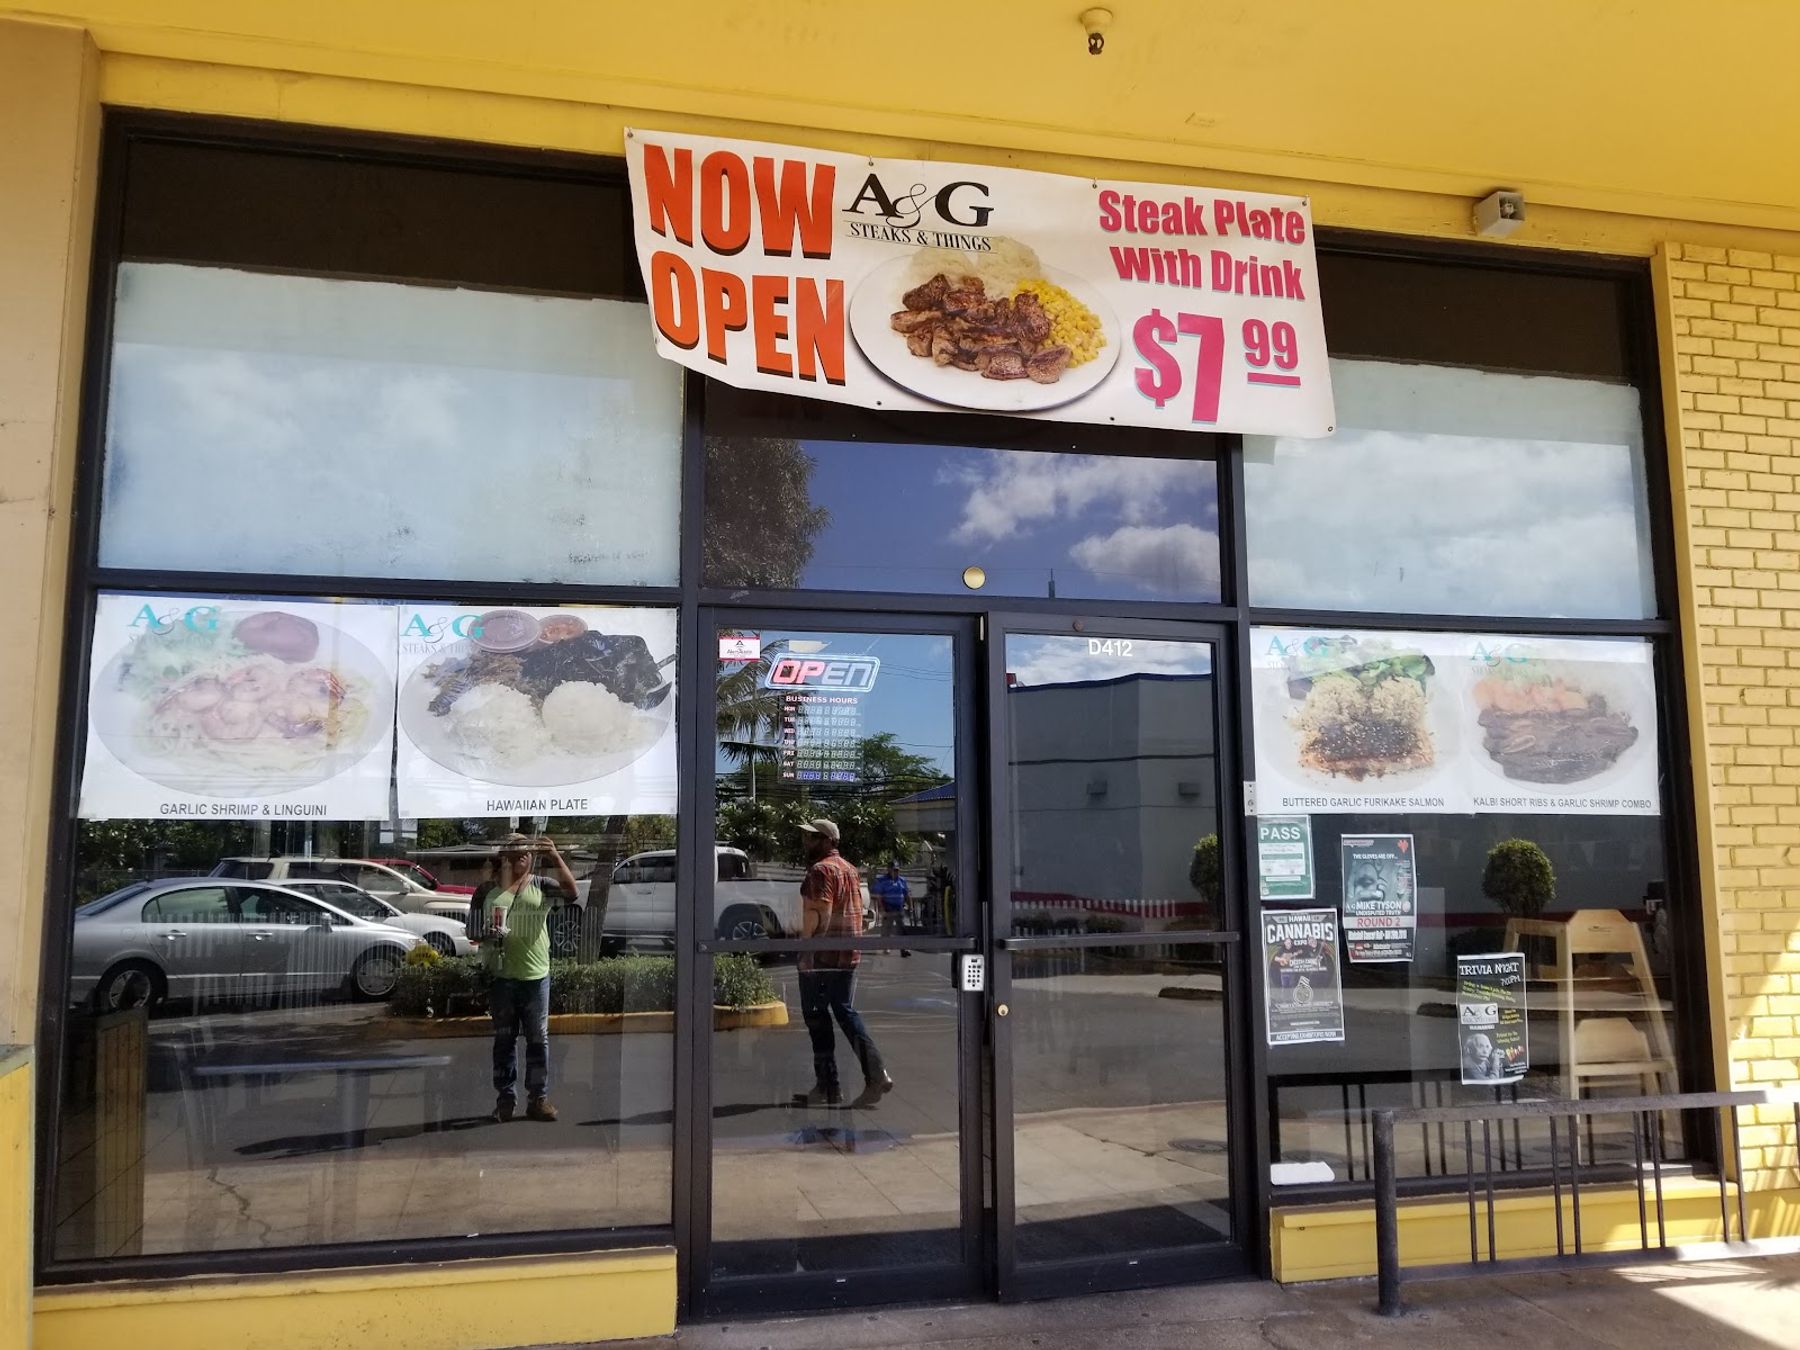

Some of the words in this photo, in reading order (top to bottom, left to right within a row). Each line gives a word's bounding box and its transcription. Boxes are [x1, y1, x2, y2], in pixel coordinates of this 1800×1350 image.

[644, 144, 836, 260] NOW
[842, 173, 994, 228] A&G
[1099, 190, 1208, 236] Steak
[1214, 199, 1306, 244] Plate
[850, 222, 911, 243] STEAKS
[916, 230, 928, 245] &
[932, 231, 992, 251] THINGS
[1109, 246, 1202, 288] With
[1210, 250, 1306, 300] Drink
[651, 250, 846, 387] OPEN
[1088, 639, 1133, 657] D412
[772, 659, 872, 686] OPEN
[785, 695, 828, 704] BUSINESS
[160, 803, 207, 815] GARLIC
[211, 804, 258, 815] SHRIMP
[262, 804, 270, 816] &
[274, 804, 327, 816] LINGUINI
[486, 799, 547, 811] HAWAIIAN
[550, 798, 588, 810] PLATE
[1282, 797, 1328, 807] BUTTERED
[1329, 797, 1362, 807] GARLIC
[1364, 797, 1407, 807] FURIKAKE
[1408, 797, 1445, 807] SALMON
[1473, 797, 1498, 807] KALBI
[1500, 797, 1528, 807] SHORT
[1529, 798, 1549, 807] RIBS
[1550, 798, 1557, 808] &
[1558, 798, 1588, 808] GARLIC
[1589, 799, 1620, 808] SHRIMP
[1621, 799, 1652, 809] COMBO
[1260, 827, 1301, 840] PASS
[1356, 900, 1376, 910] MIKE
[1378, 900, 1402, 910] TYSON
[1357, 916, 1393, 928] ROUND
[1267, 922, 1334, 944] CANNABIS
[1459, 964, 1493, 976] TRIVIA
